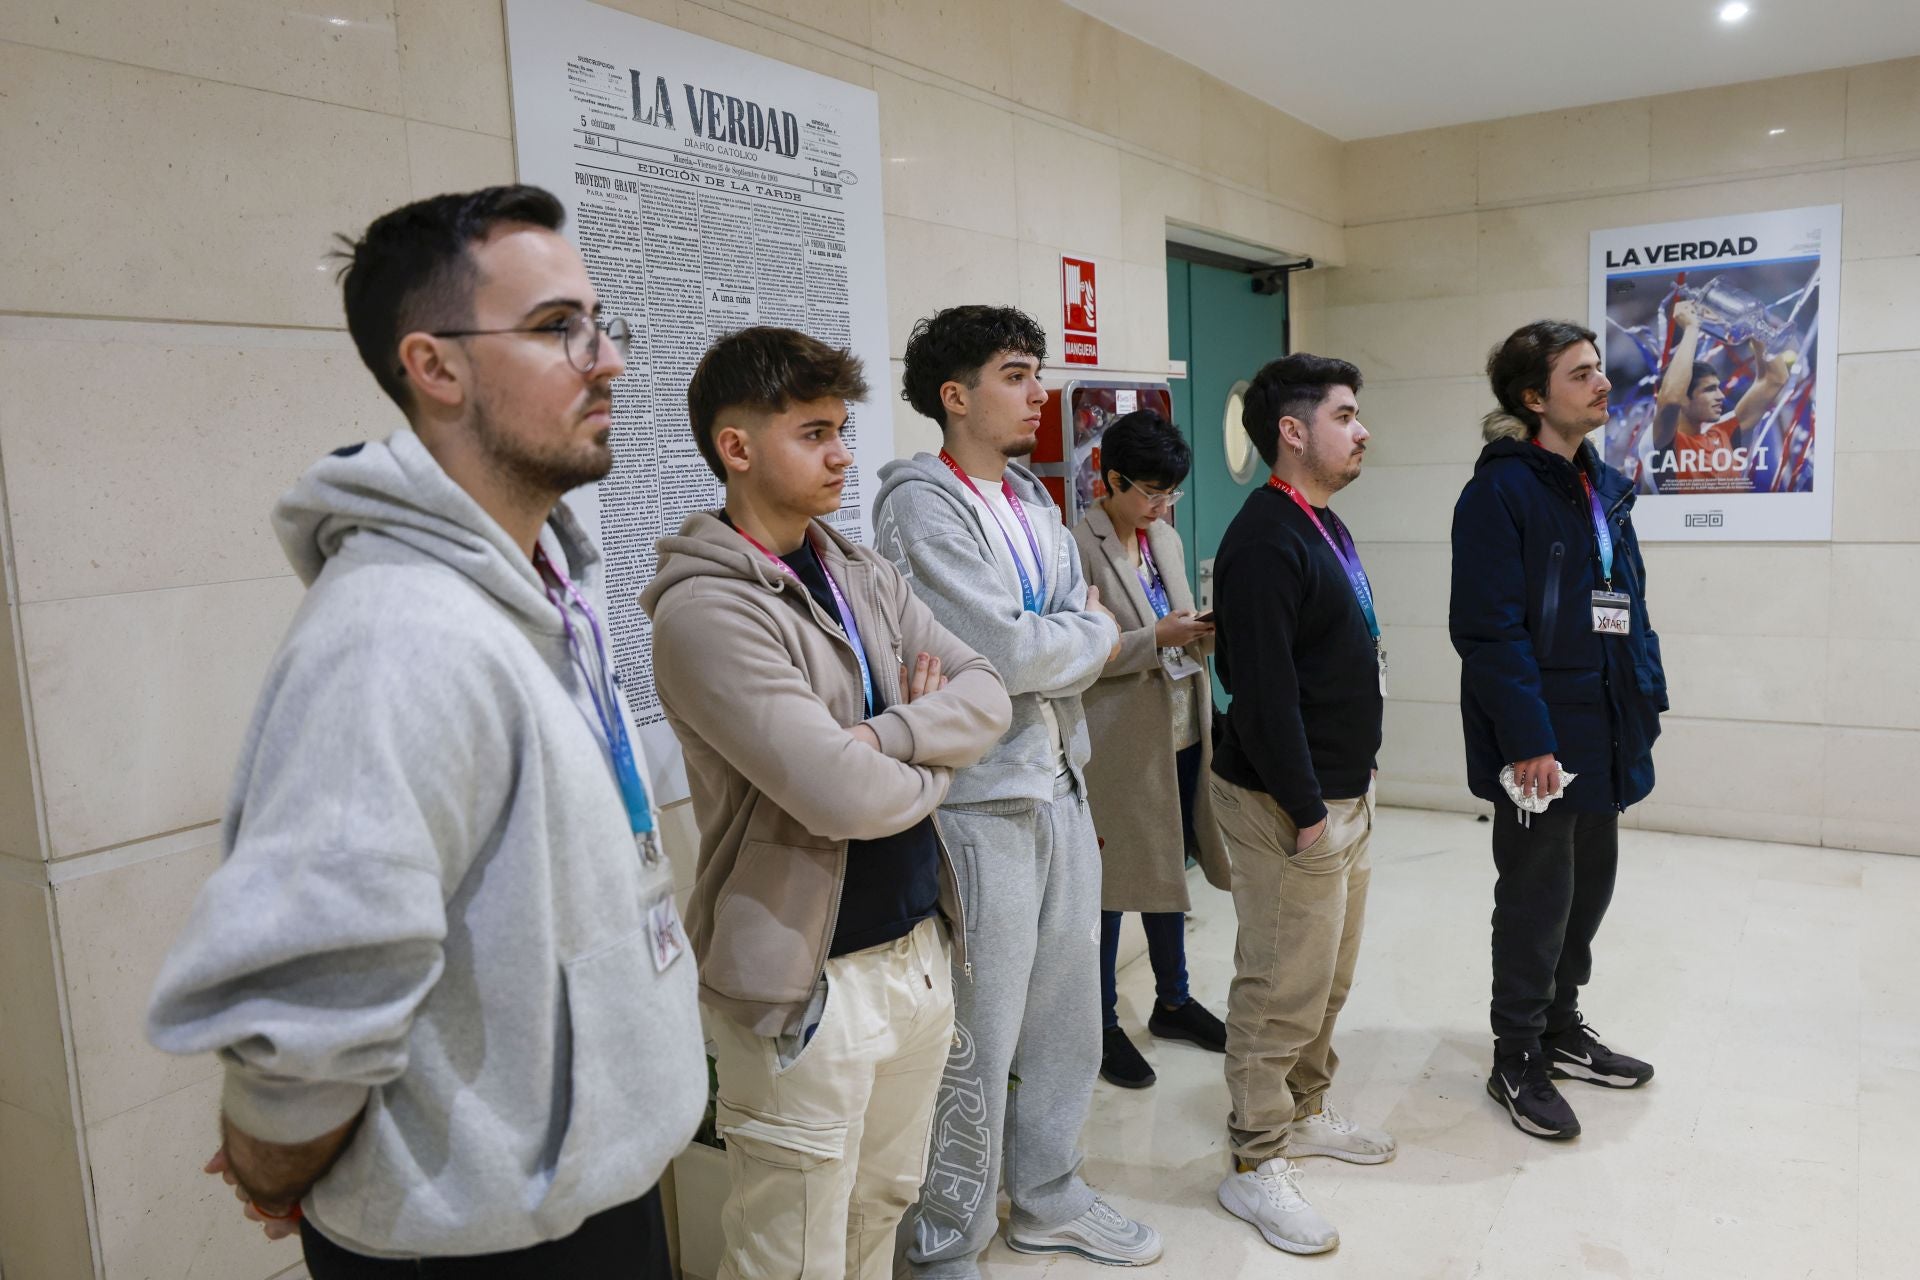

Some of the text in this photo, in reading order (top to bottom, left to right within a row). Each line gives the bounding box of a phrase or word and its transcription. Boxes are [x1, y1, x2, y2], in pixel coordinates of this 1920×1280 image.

[580, 115, 587, 127] 5
[628, 68, 676, 131] LA
[683, 83, 799, 160] VERDAD
[684, 138, 758, 162] DIARIO CATOLICO
[813, 166, 818, 177] 5
[574, 171, 638, 194] PROYECTO GRAVE
[637, 163, 802, 202] EDICIÓN DE LA TARDE
[586, 188, 628, 201] PARA MURCIA
[1605, 236, 1759, 268] LA VERDAD
[711, 291, 752, 304] A una niña
[1065, 341, 1097, 357] MANGUERA
[1644, 446, 1769, 474] CARLOS I
[1684, 513, 1724, 528] 120
[1596, 615, 1628, 630] XTART
